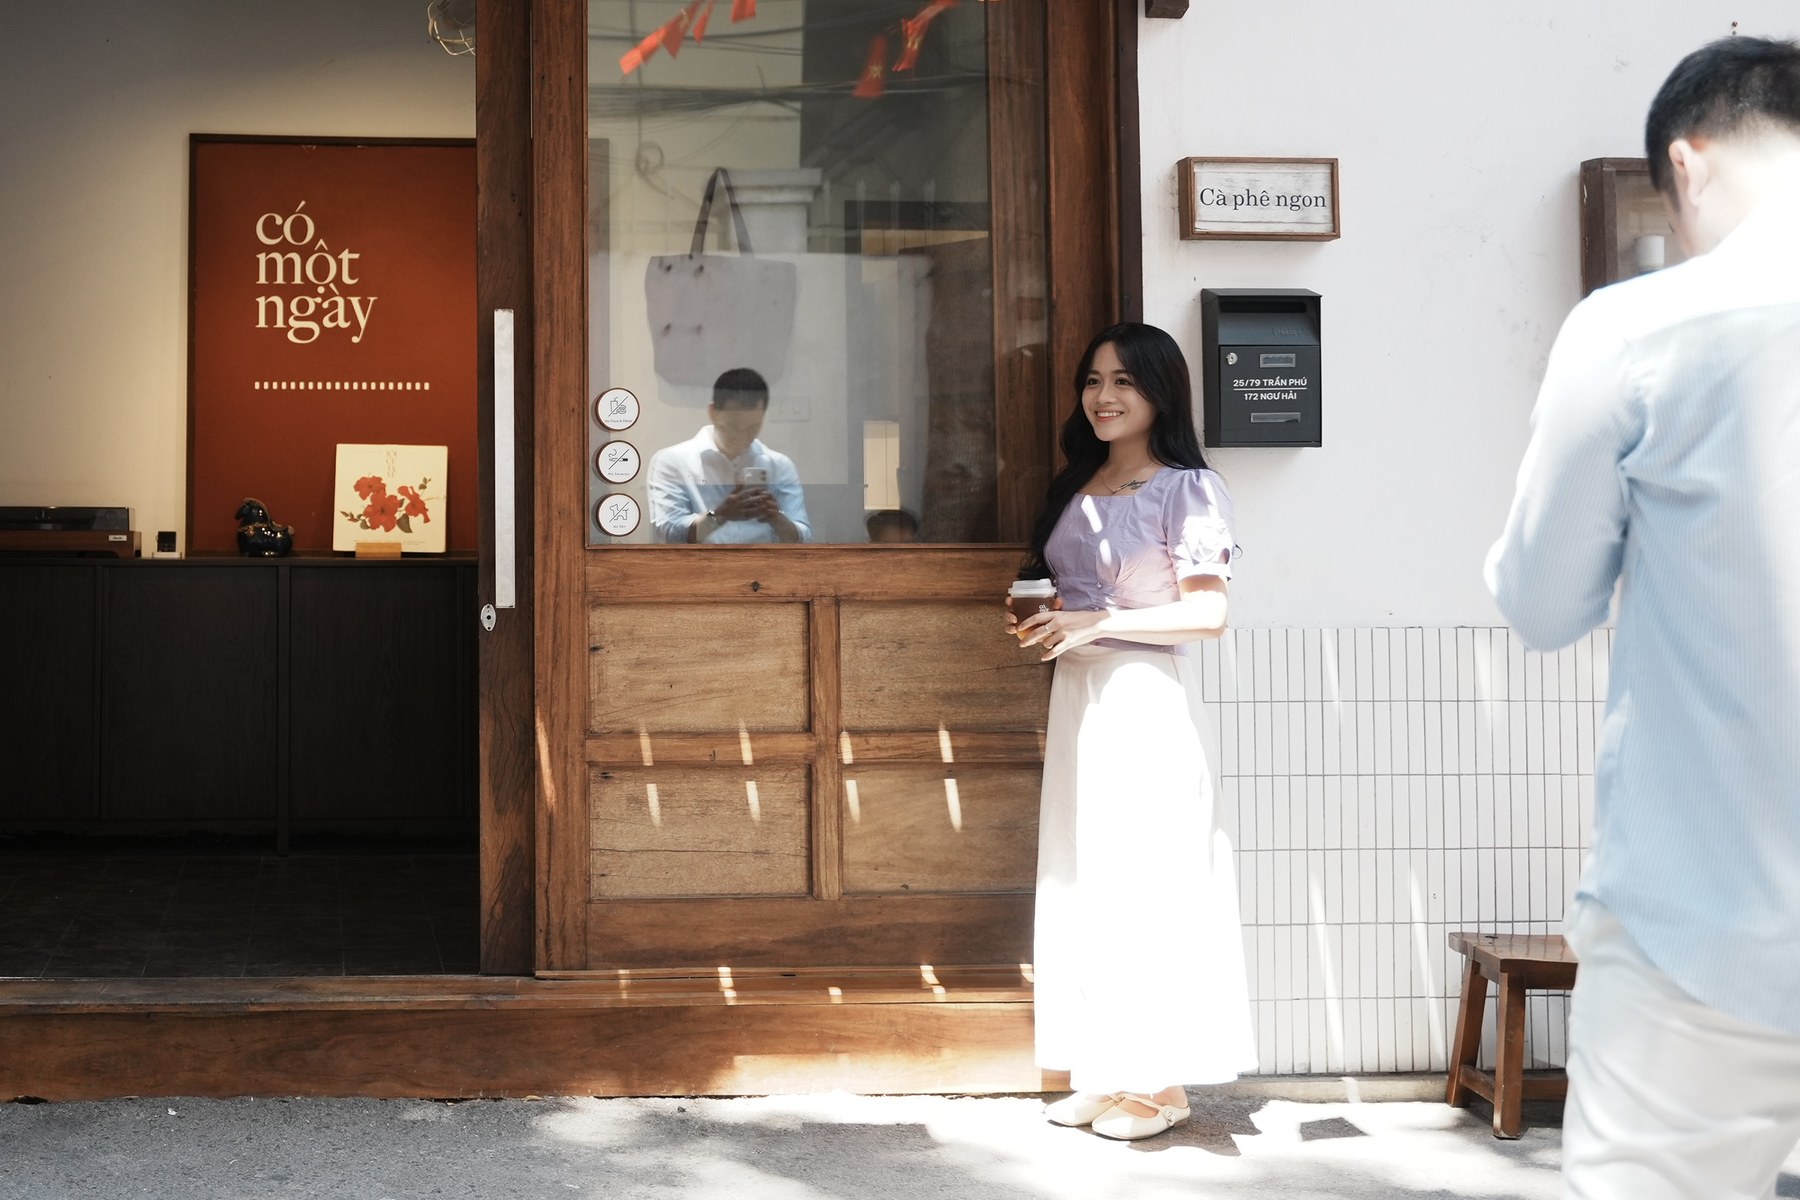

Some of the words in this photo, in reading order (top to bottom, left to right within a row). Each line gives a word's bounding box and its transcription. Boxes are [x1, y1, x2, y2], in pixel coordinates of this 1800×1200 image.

[1199, 187, 1228, 206] Cà
[1232, 188, 1271, 211] phê
[1275, 193, 1328, 212] ngon
[255, 200, 315, 246] có
[255, 238, 361, 294] một
[255, 282, 378, 344] ngày
[1232, 379, 1261, 387] 25/79
[1288, 376, 1308, 387] PHÚ
[1243, 392, 1259, 401] 172
